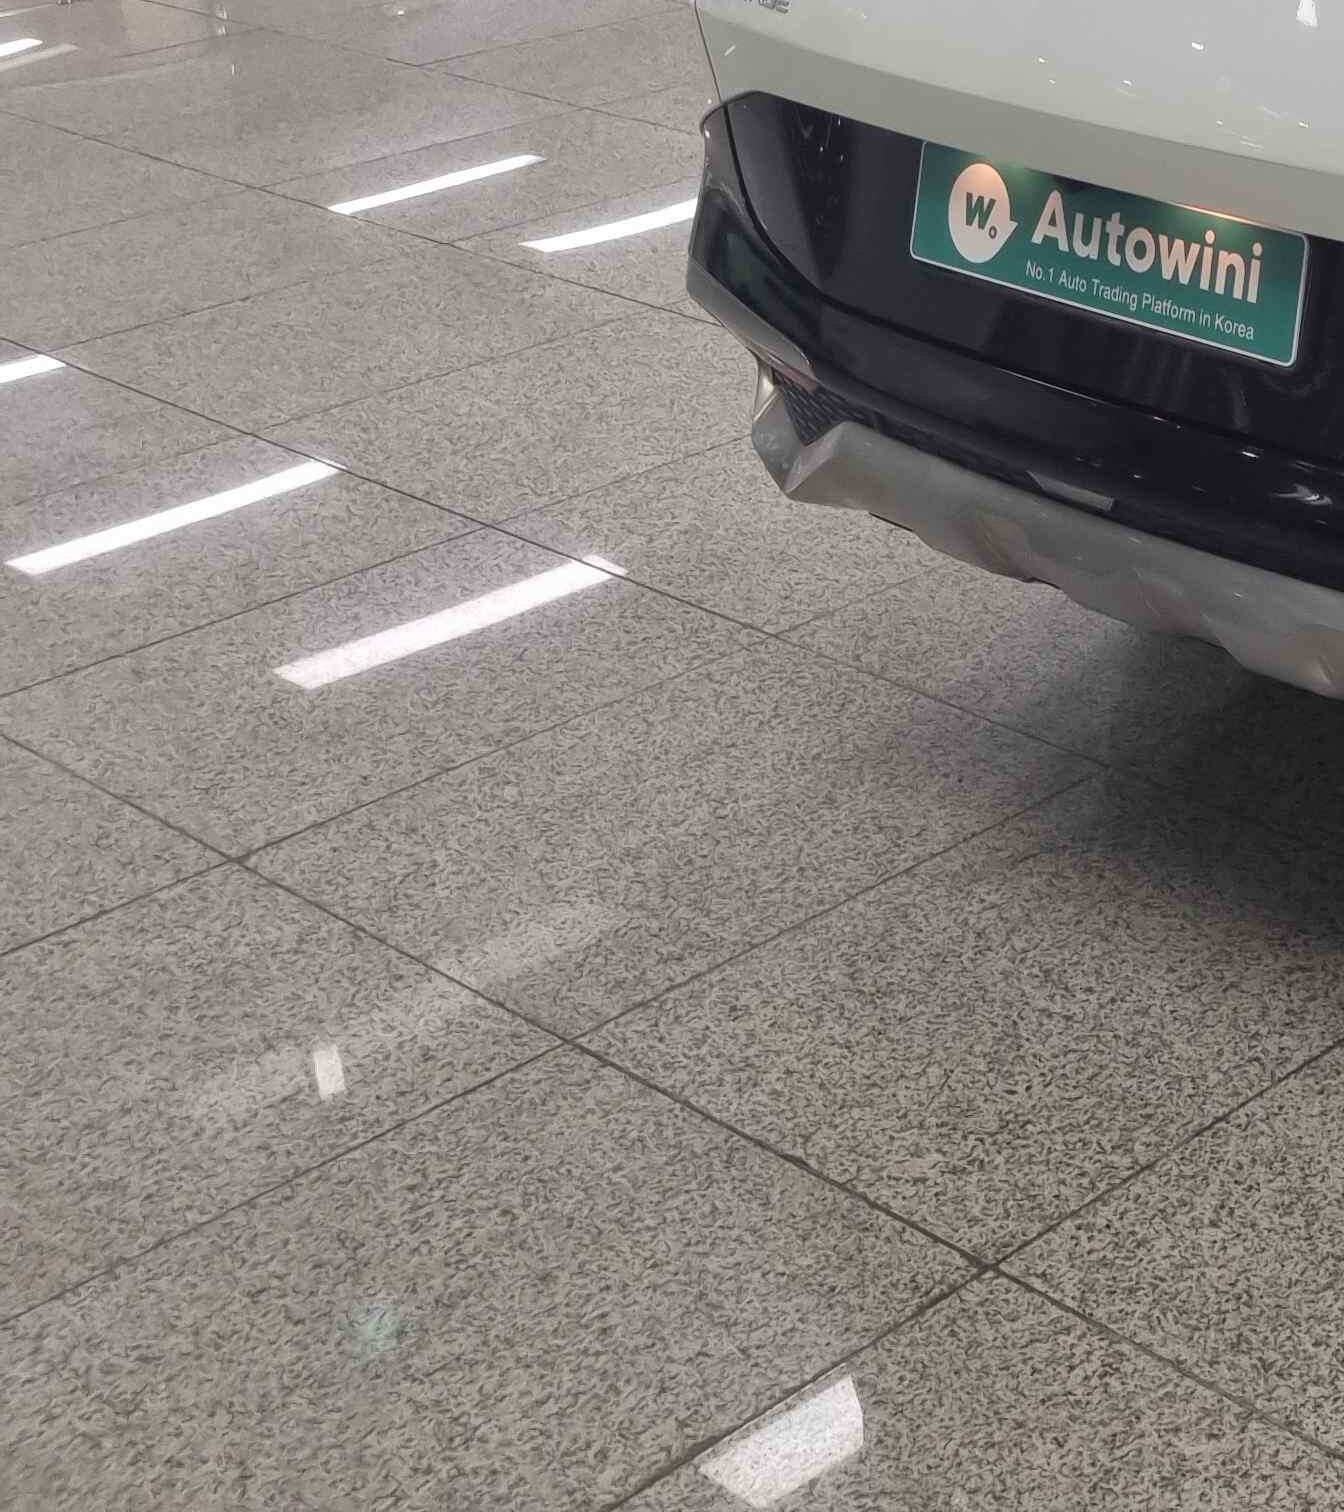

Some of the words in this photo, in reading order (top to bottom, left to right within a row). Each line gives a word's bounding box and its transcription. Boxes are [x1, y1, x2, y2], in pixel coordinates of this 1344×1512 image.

[1031, 190, 1264, 304] Autowini
[1058, 270, 1088, 293] Auto
[1092, 278, 1138, 311] Trading
[1142, 292, 1197, 323] Platform
[1199, 308, 1211, 328] in
[1214, 312, 1255, 340] Korea
